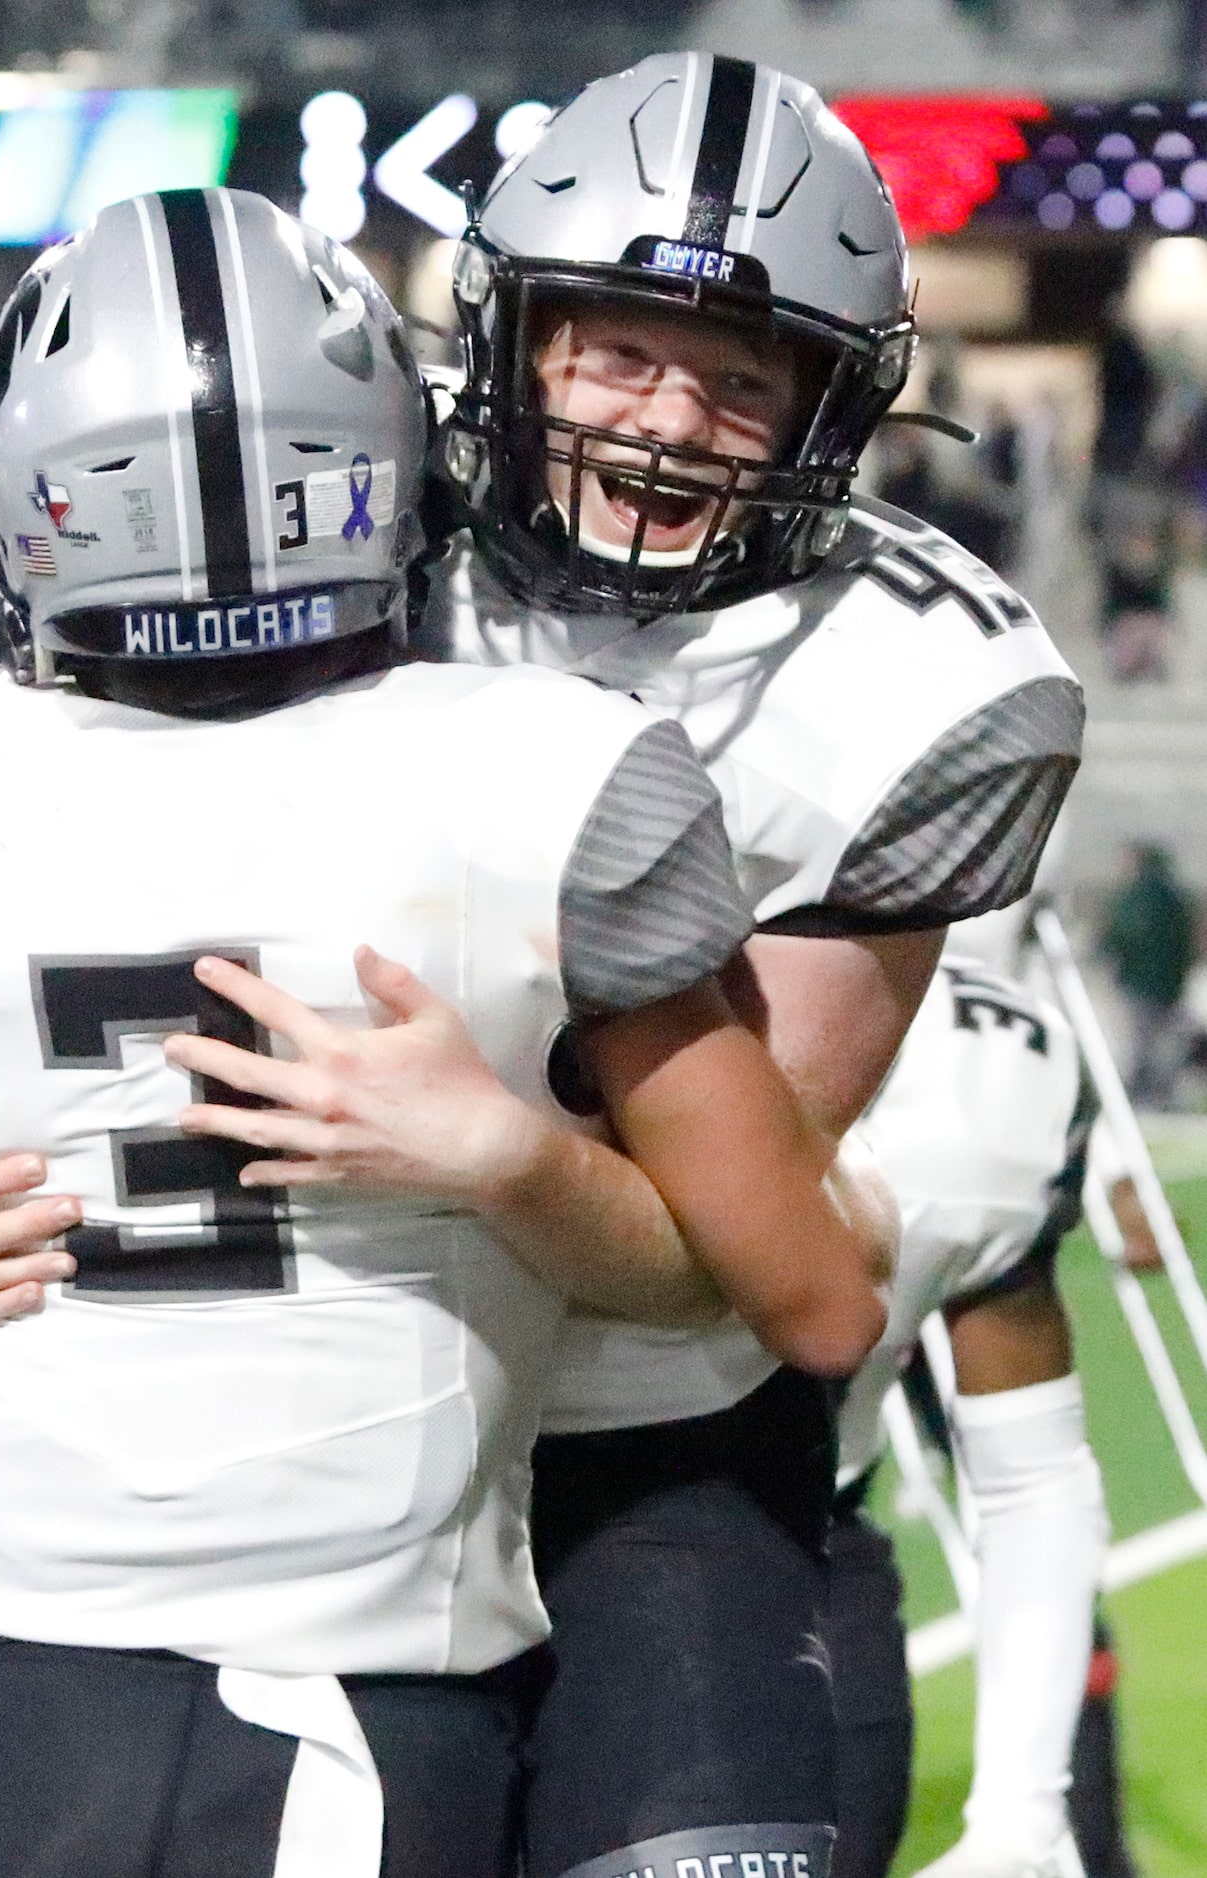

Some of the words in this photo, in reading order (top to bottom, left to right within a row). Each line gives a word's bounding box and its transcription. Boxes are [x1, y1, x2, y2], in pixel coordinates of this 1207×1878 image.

[655, 241, 735, 282] GUYER
[269, 478, 309, 552] 3
[125, 595, 336, 653] WILDCATS
[28, 946, 300, 1303] 3
